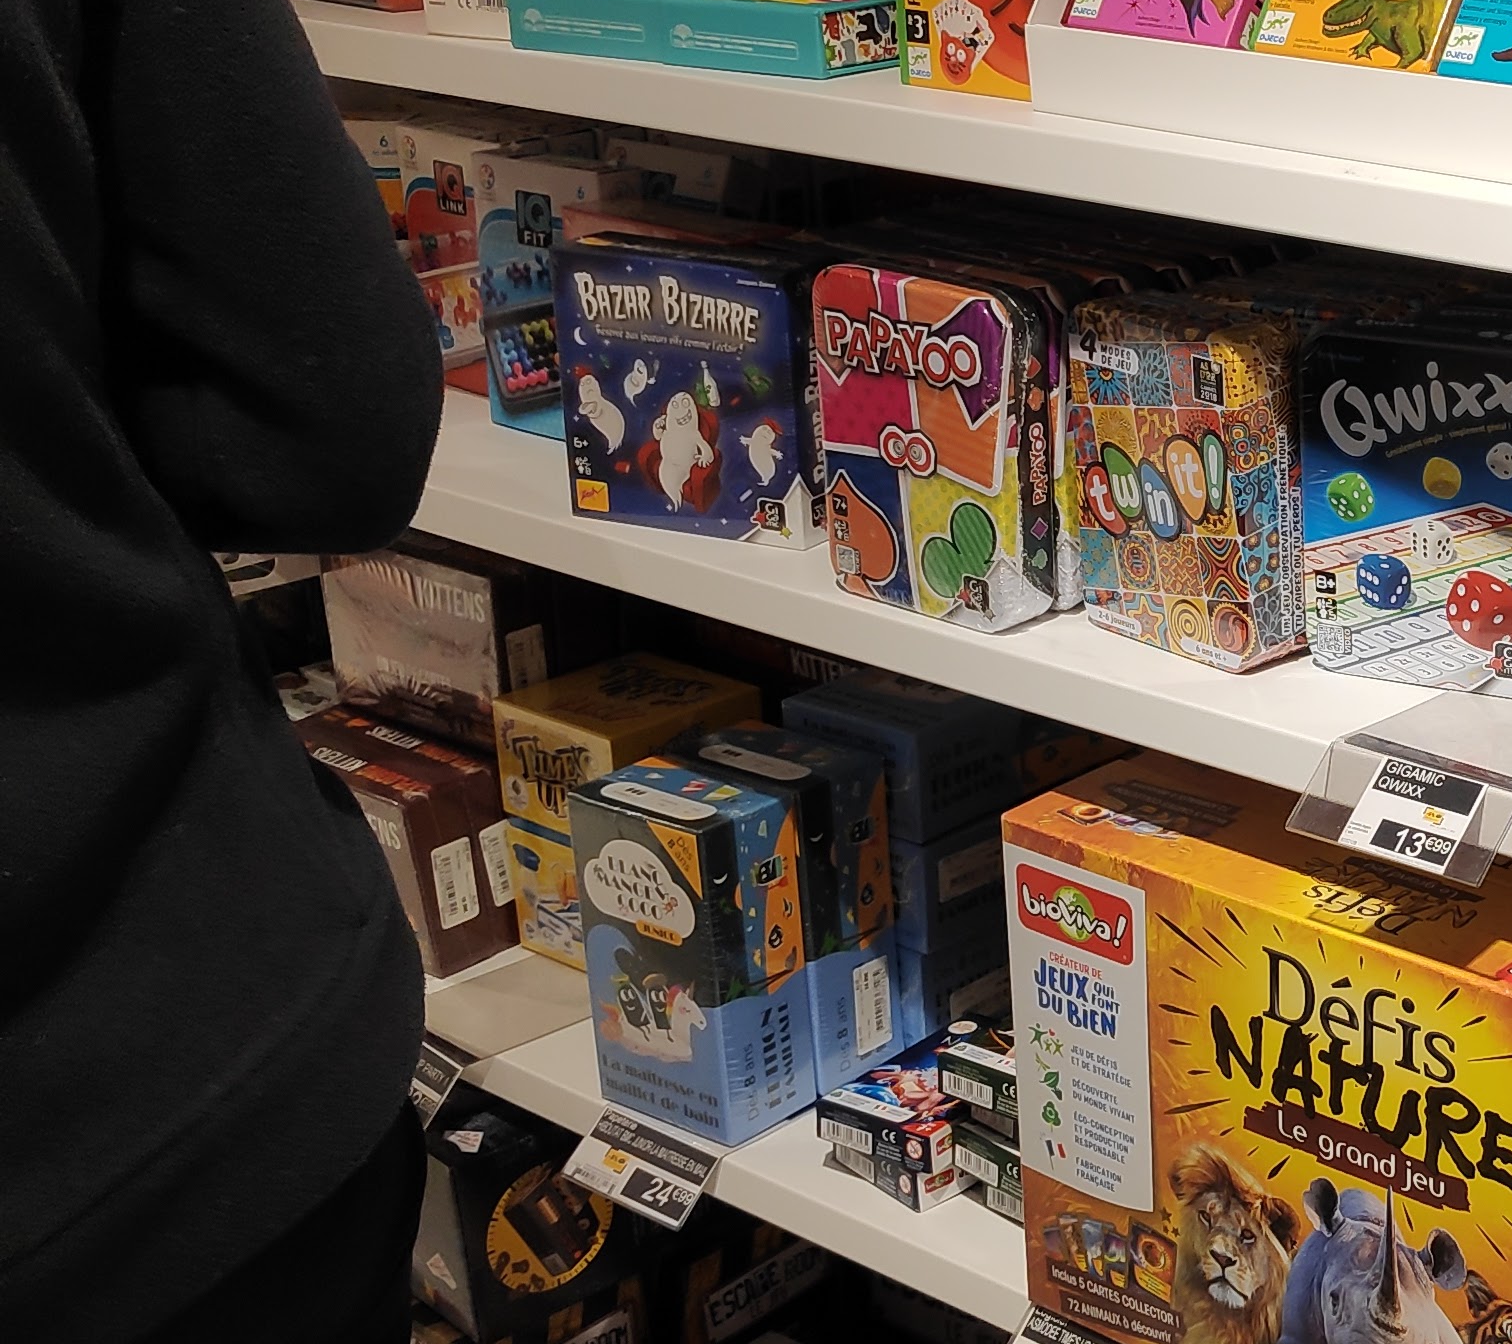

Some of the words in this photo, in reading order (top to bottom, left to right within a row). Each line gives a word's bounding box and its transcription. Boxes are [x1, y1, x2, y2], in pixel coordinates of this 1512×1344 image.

[438, 195, 468, 217] LINK
[522, 231, 547, 247] FIT
[573, 271, 652, 323] BAZAR
[658, 275, 760, 344] BIZARRE
[822, 309, 983, 388] PAPAYOO
[413, 576, 487, 625] KITTENS
[1376, 775, 1426, 801] QWIXX
[1385, 760, 1446, 787] GIGAMIC
[1033, 957, 1089, 1002] JEUX
[1049, 950, 1091, 976] CRÉATEUR
[1091, 967, 1103, 981] DE
[1037, 986, 1064, 1016] DU
[1262, 944, 1460, 1086] Défis
[1276, 1108, 1309, 1148] Le
[1317, 1133, 1398, 1182] grand
[1402, 1153, 1447, 1201] jeu
[1085, 1273, 1117, 1301] CARTES
